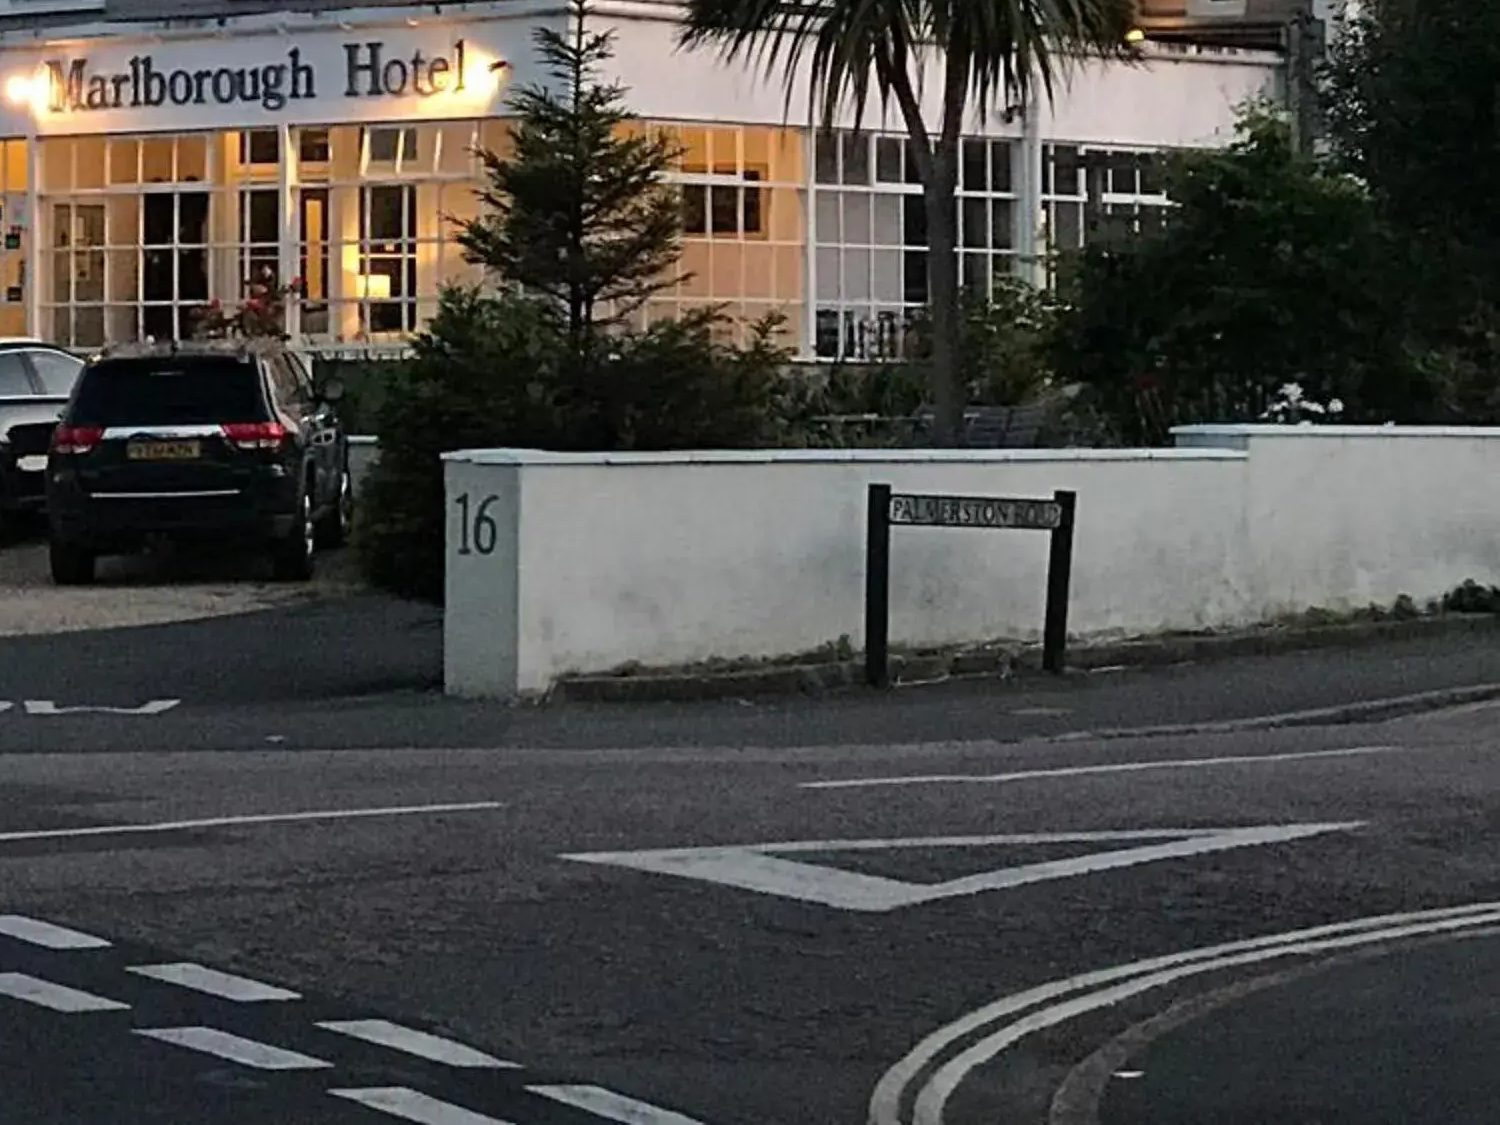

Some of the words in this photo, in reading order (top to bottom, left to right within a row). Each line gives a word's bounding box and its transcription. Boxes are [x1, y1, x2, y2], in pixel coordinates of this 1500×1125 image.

[45, 47, 316, 112] Marlborough
[343, 39, 466, 97] Hotel
[455, 492, 500, 556] 16
